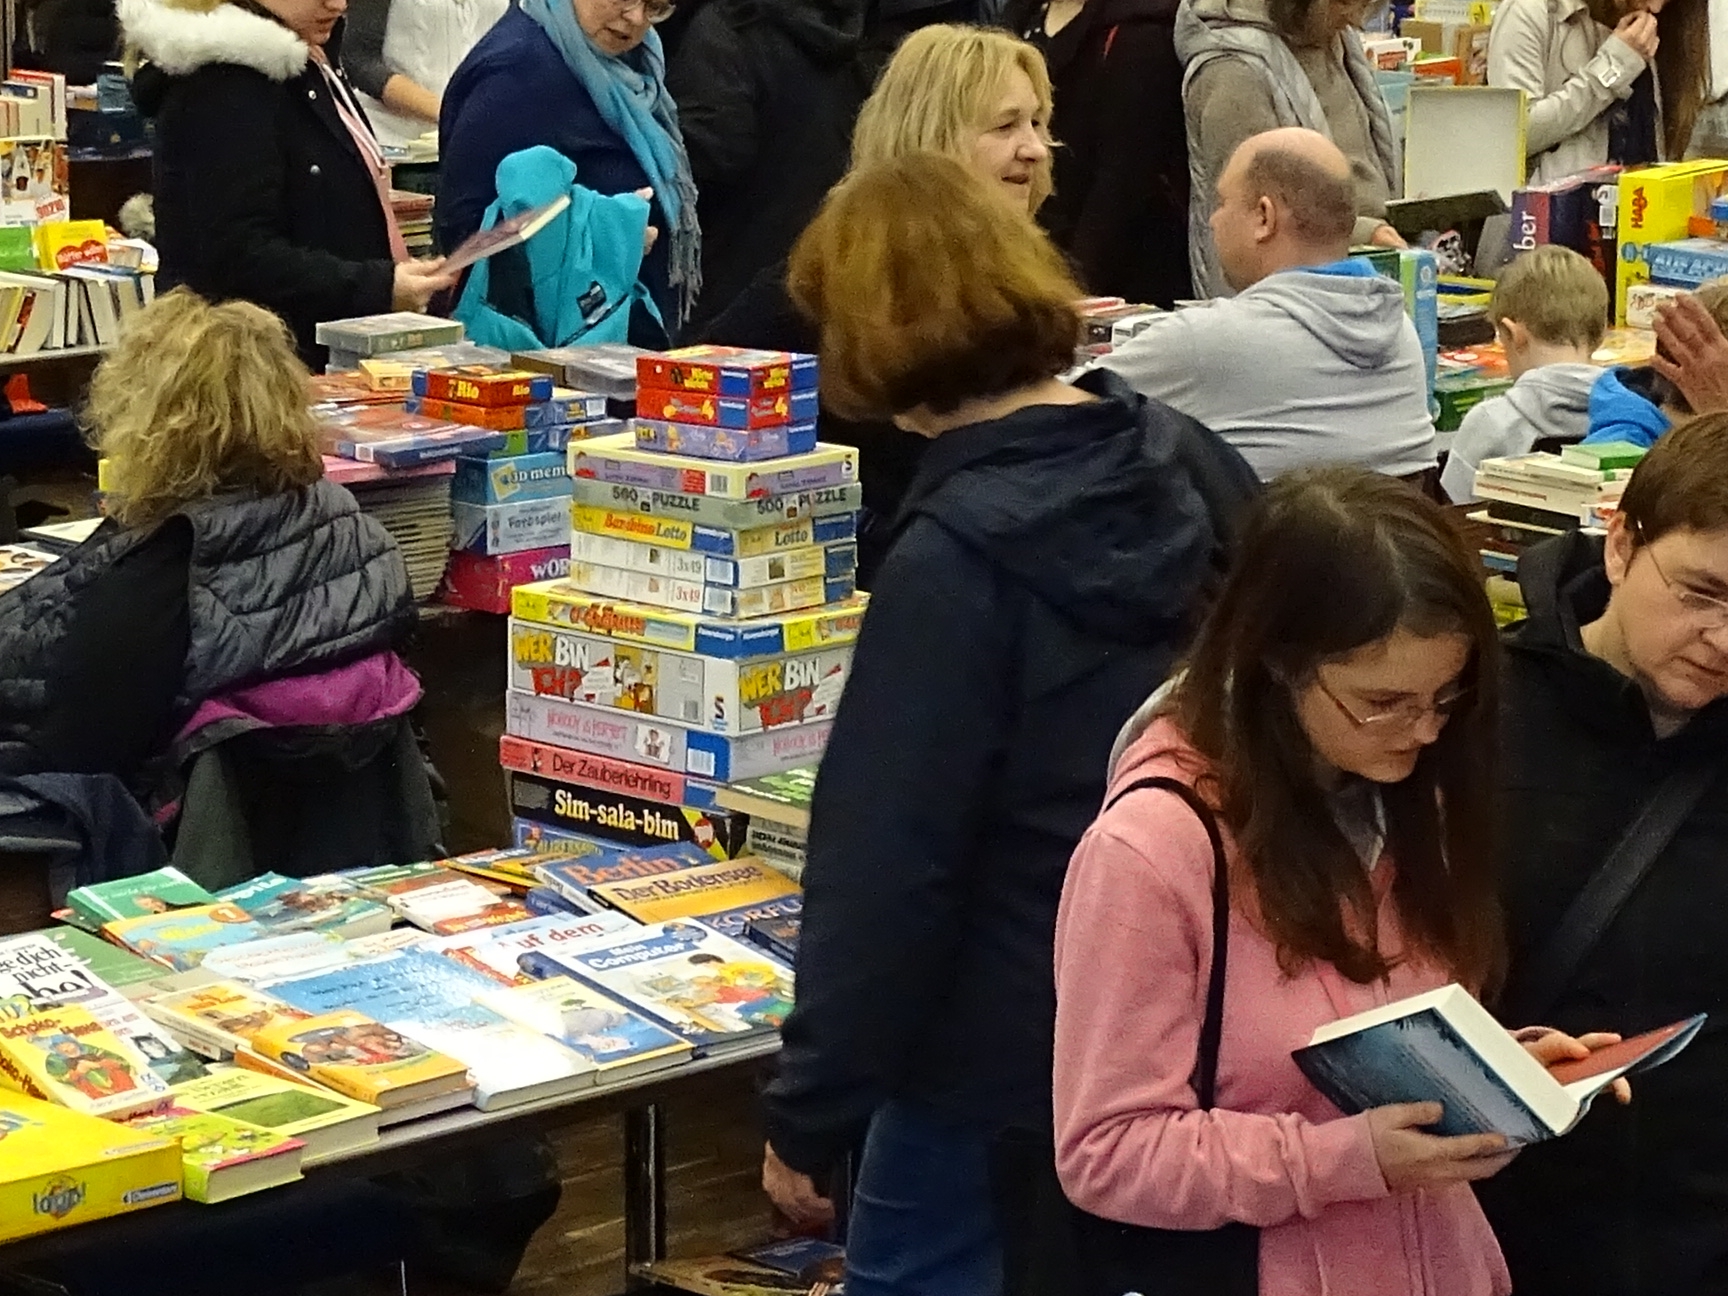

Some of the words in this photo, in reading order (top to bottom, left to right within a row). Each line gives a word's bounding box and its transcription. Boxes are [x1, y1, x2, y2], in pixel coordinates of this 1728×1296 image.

[1632, 186, 1649, 229] HABA
[457, 382, 480, 399] Rio
[612, 485, 639, 503] 500
[652, 490, 701, 512] PUZZLE
[756, 499, 784, 516] 500
[798, 487, 848, 507] PUZZLE
[656, 522, 688, 542] Lotto
[774, 529, 809, 547] Lotto
[677, 557, 702, 575] 3x49
[676, 585, 701, 604] 3x49
[514, 631, 555, 663] WER
[555, 635, 590, 672] BIN
[739, 663, 783, 700] WER
[783, 658, 821, 692] BIN
[551, 753, 578, 775] Der
[579, 757, 672, 797] Zauberlehrling
[553, 787, 680, 842] Sim-sala-bim
[565, 857, 680, 886] Berlin
[612, 883, 659, 903] Der
[659, 863, 762, 896] Bodensee
[548, 920, 604, 944] dem
[15, 944, 63, 968] dich
[588, 941, 687, 971] Computer
[59, 1020, 104, 1037] Hexe
